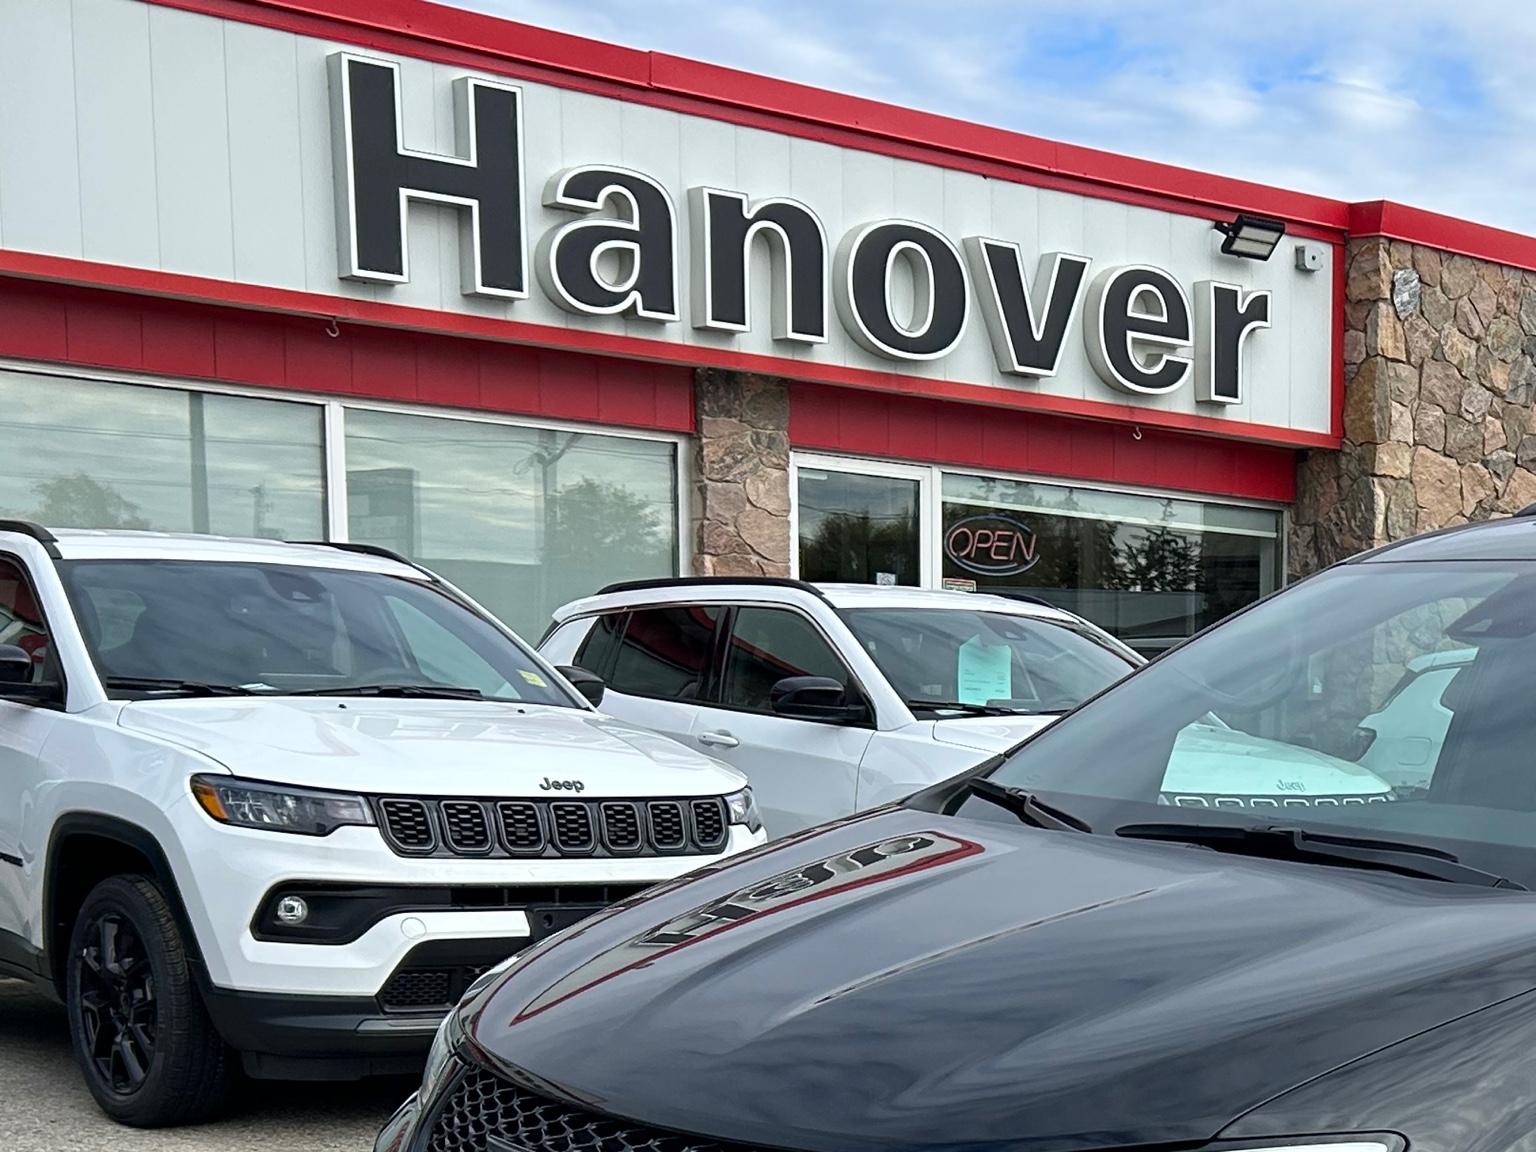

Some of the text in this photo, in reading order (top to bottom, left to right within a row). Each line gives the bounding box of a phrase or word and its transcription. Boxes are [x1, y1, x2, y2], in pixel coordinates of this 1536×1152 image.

[329, 51, 1271, 405] Hanover
[949, 527, 1037, 561] OPEN
[539, 777, 585, 793] Jeep
